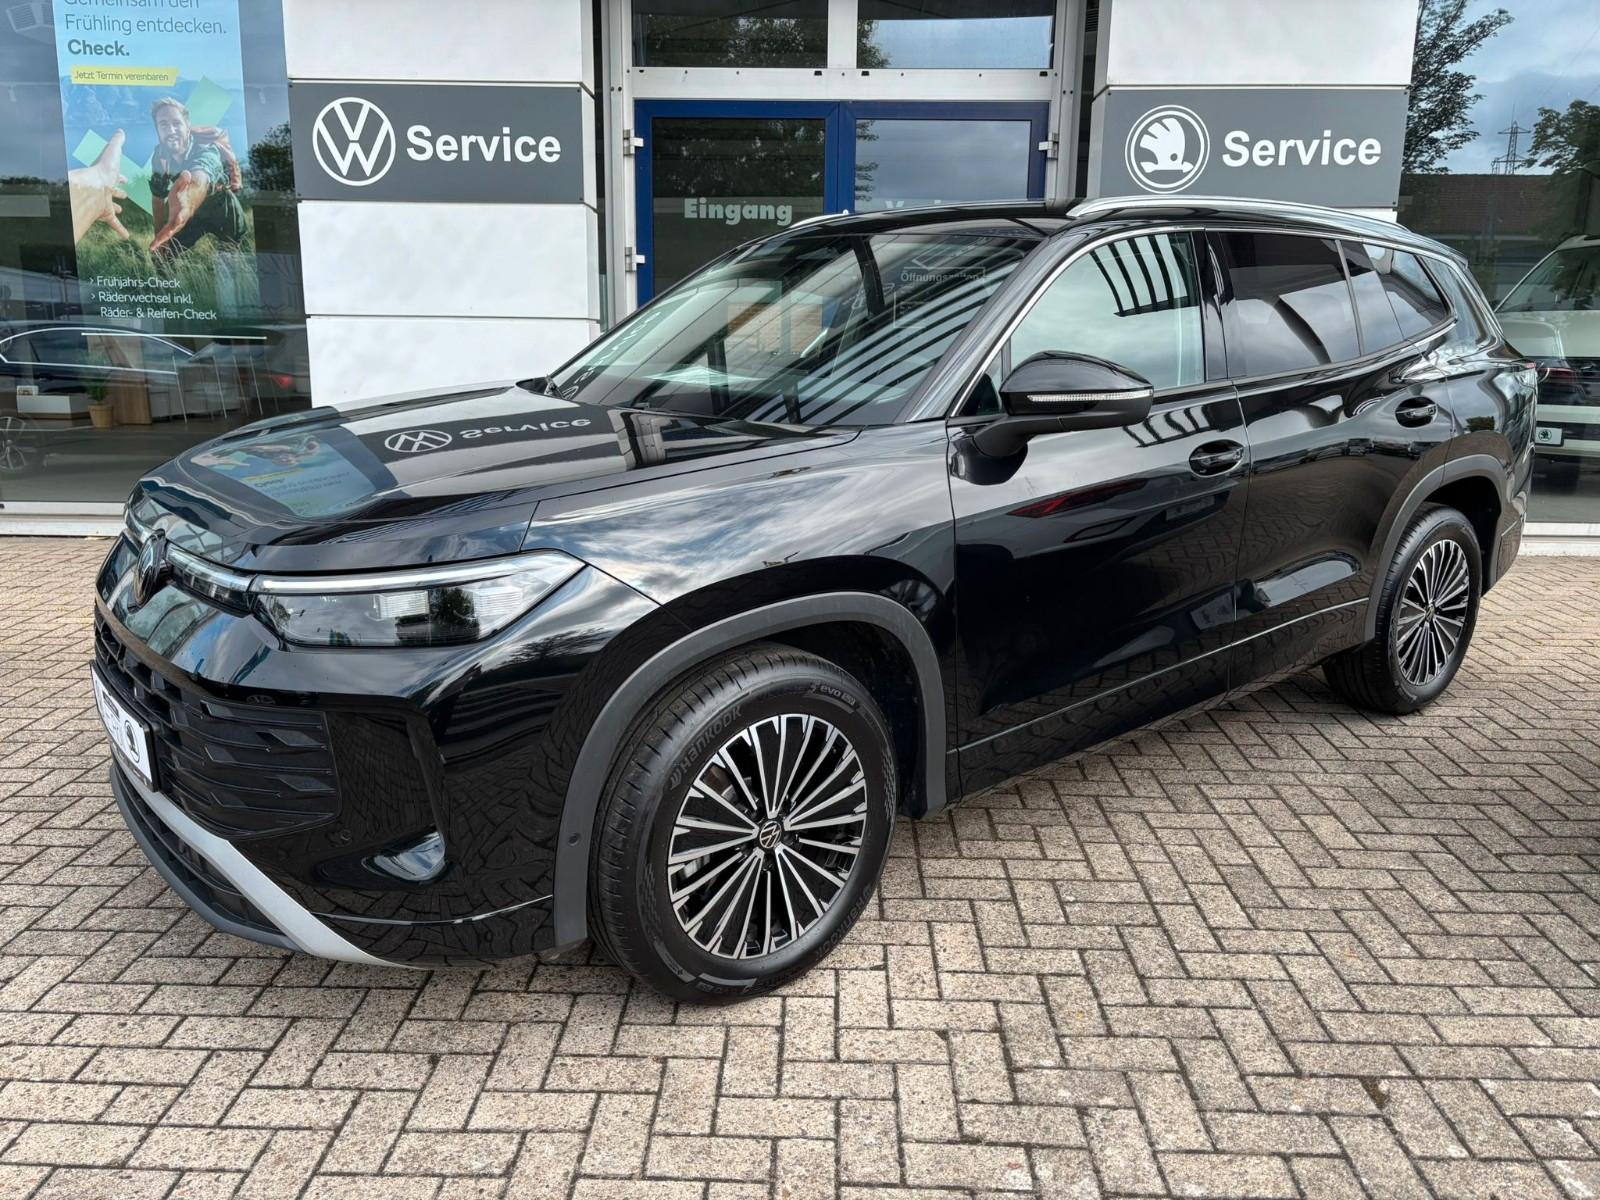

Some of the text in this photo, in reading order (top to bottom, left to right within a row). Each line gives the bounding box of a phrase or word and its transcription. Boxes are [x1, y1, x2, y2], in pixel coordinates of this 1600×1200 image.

[65, 14, 228, 36] Frühling entdecken.
[67, 39, 131, 57] Check.
[74, 71, 169, 82] Jetzt Termin vereinbaren
[406, 125, 562, 163] Service
[1222, 130, 1383, 168] Service
[684, 198, 793, 226] Eingang
[96, 275, 181, 289] Frühjahrs-Check
[98, 291, 194, 305] Räderwechsel inkl.
[100, 306, 217, 320] Räder- & Reifen-Check
